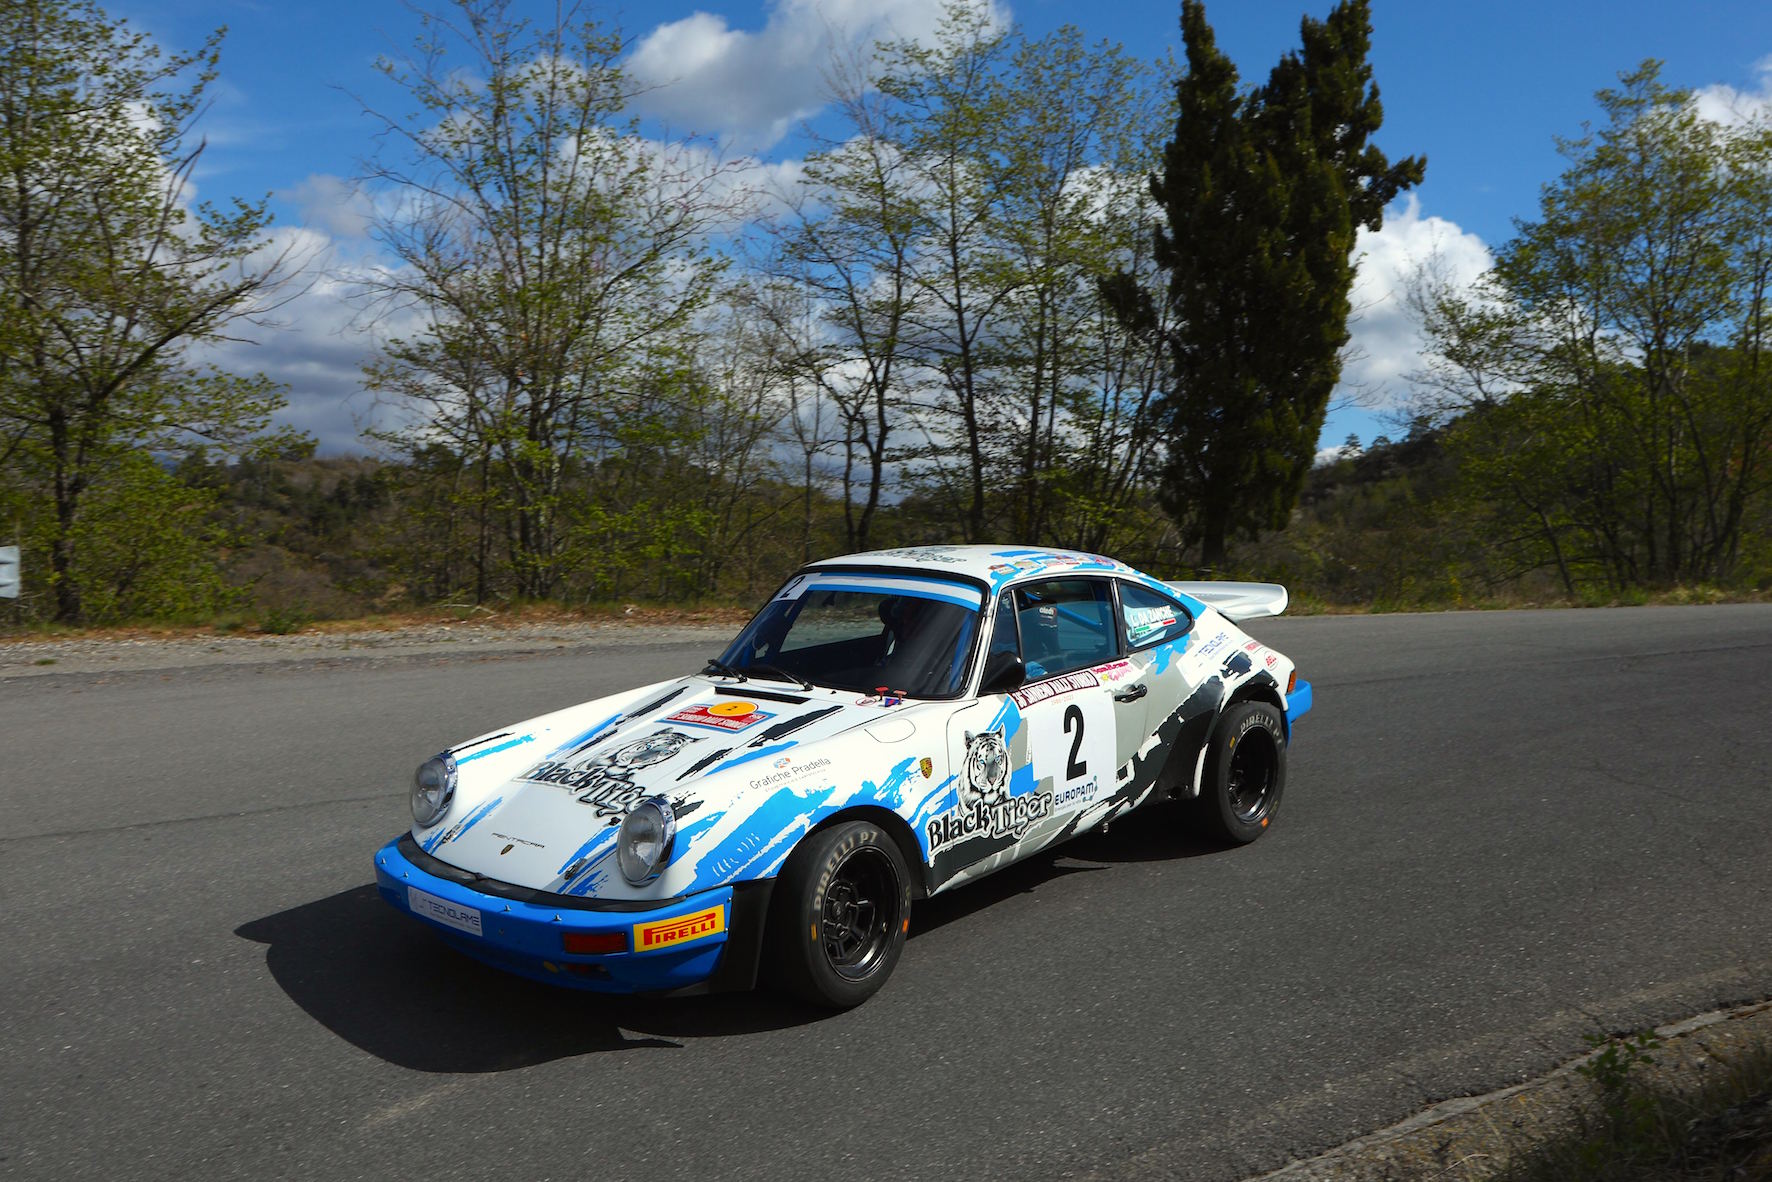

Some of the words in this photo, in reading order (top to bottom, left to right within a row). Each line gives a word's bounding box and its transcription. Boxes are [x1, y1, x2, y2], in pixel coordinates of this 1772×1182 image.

[779, 575, 806, 599] 2
[1021, 681, 1055, 704] SANREMO
[1048, 676, 1073, 694] RALLY
[1066, 670, 1098, 690] STORICO
[1240, 714, 1274, 734] PIRELLI
[1063, 704, 1087, 781] 2
[517, 759, 607, 792] Black
[749, 770, 792, 790] Grafiche
[791, 757, 832, 775] Pradella
[926, 801, 991, 849] Black
[990, 792, 1052, 836] Tiger
[813, 836, 855, 911] PIRELLI
[643, 911, 717, 946] PIRELLI
